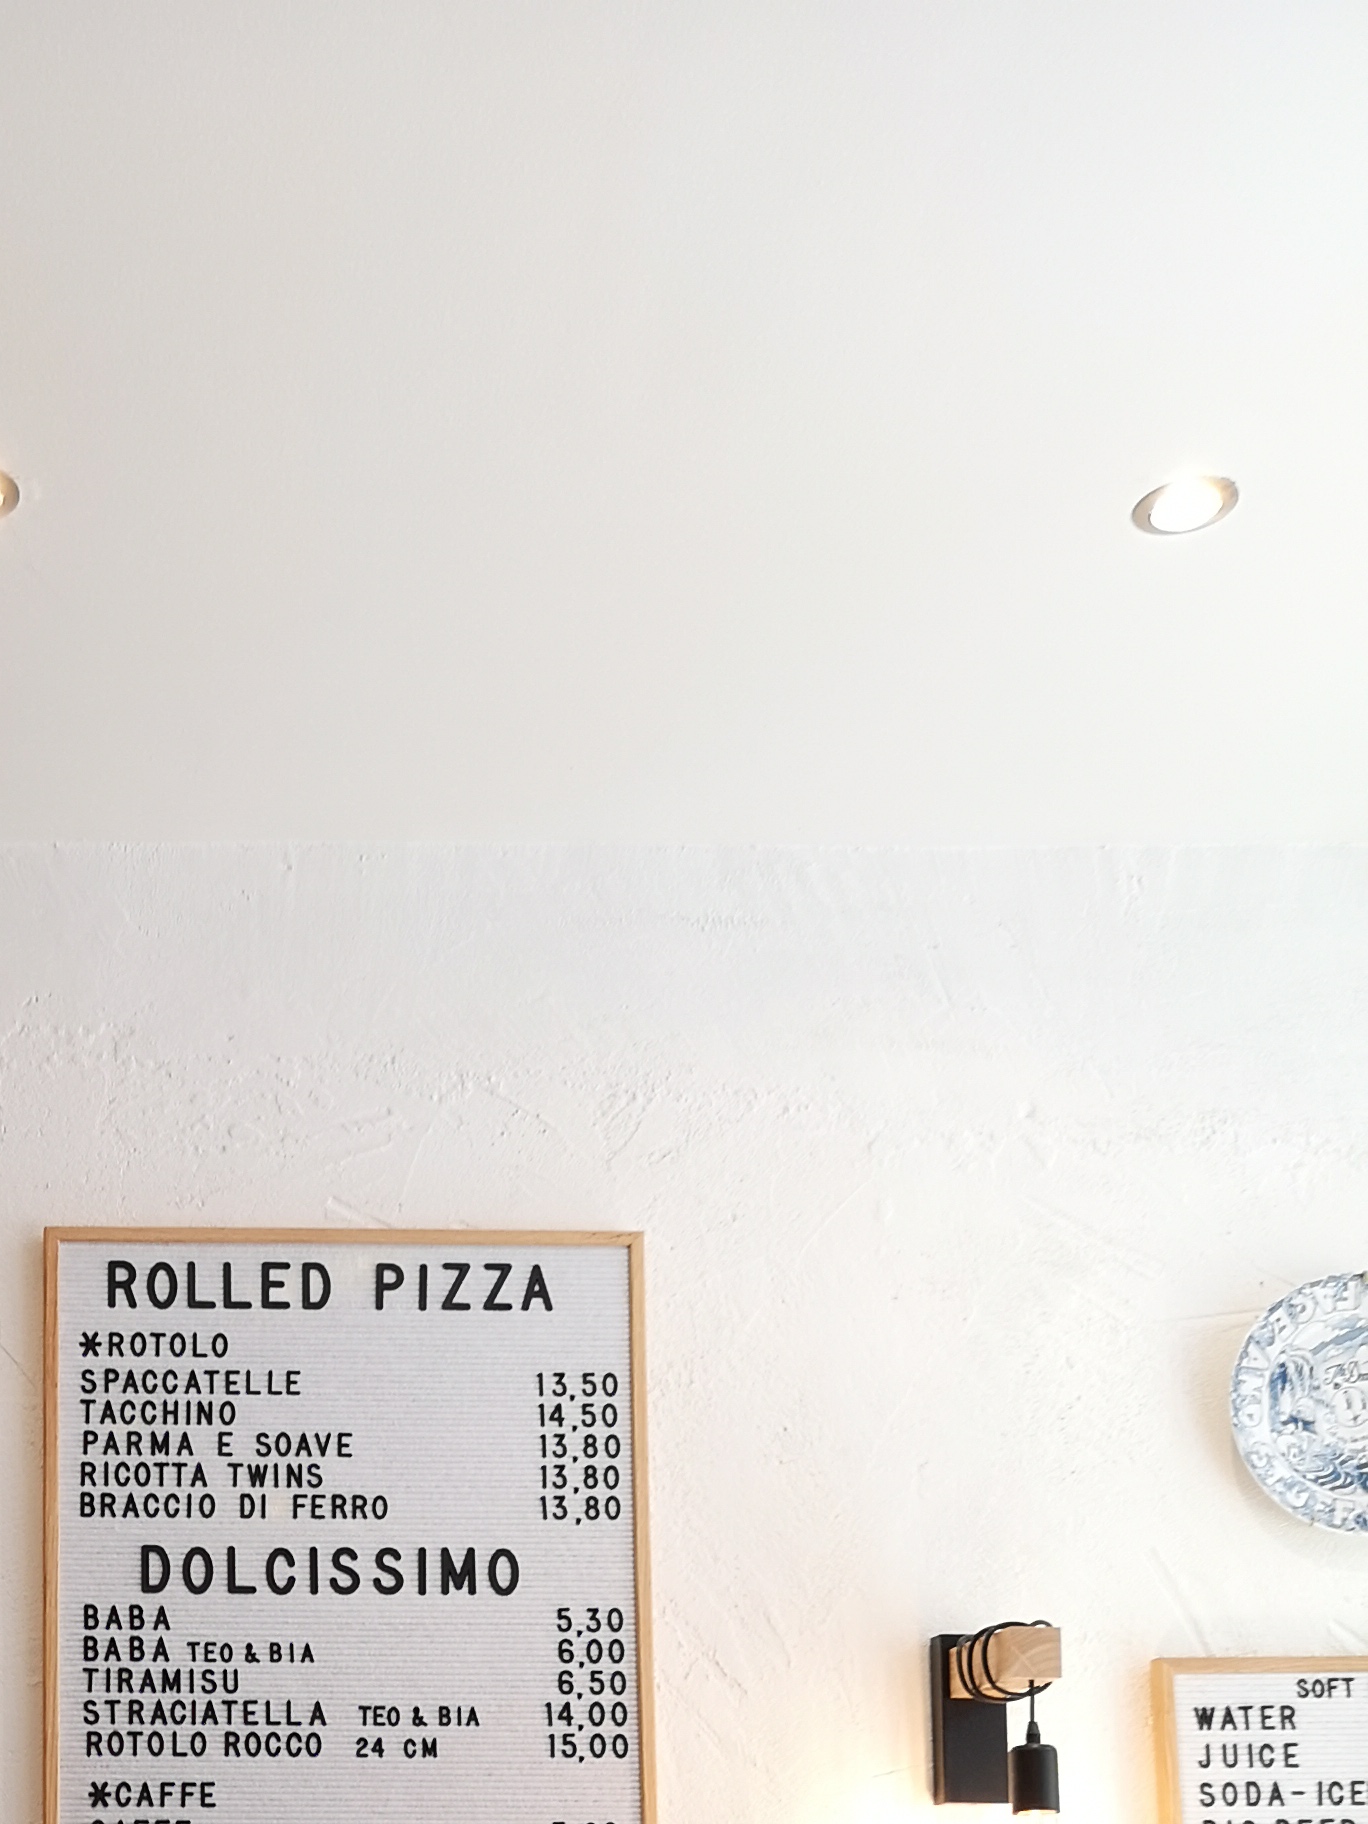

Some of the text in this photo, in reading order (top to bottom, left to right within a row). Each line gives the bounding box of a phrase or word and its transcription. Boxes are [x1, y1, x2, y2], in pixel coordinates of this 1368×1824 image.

[106, 1259, 554, 1312] ROLLED PIZZA
[80, 1367, 619, 1402] SPACCATELLE 13,50
[79, 1398, 618, 1433] TACCHINO 14,50
[82, 1429, 621, 1463] PARMA E SOAVE 13,80
[79, 1460, 620, 1495] RICOTTA TWINS 13,80
[79, 1491, 621, 1526] BRACCIO DI FERRO 13,80
[139, 1544, 520, 1597] DOLCISSIMO
[83, 1603, 624, 1637] BABA 5,30
[82, 1635, 625, 1669] BABA TEO & BIA 6,00
[82, 1667, 627, 1700] TIRAMISU 6,50
[1296, 1677, 1355, 1699] SOFT
[83, 1698, 628, 1732] STRACIATELLA TEO & BIA 14,00
[1193, 1704, 1296, 1731] WATER
[85, 1729, 629, 1764] ROTOLO ROCCO 24 CM 15,00
[1197, 1742, 1300, 1769] JUICE
[1199, 1780, 1368, 1808] SODA-ICE
